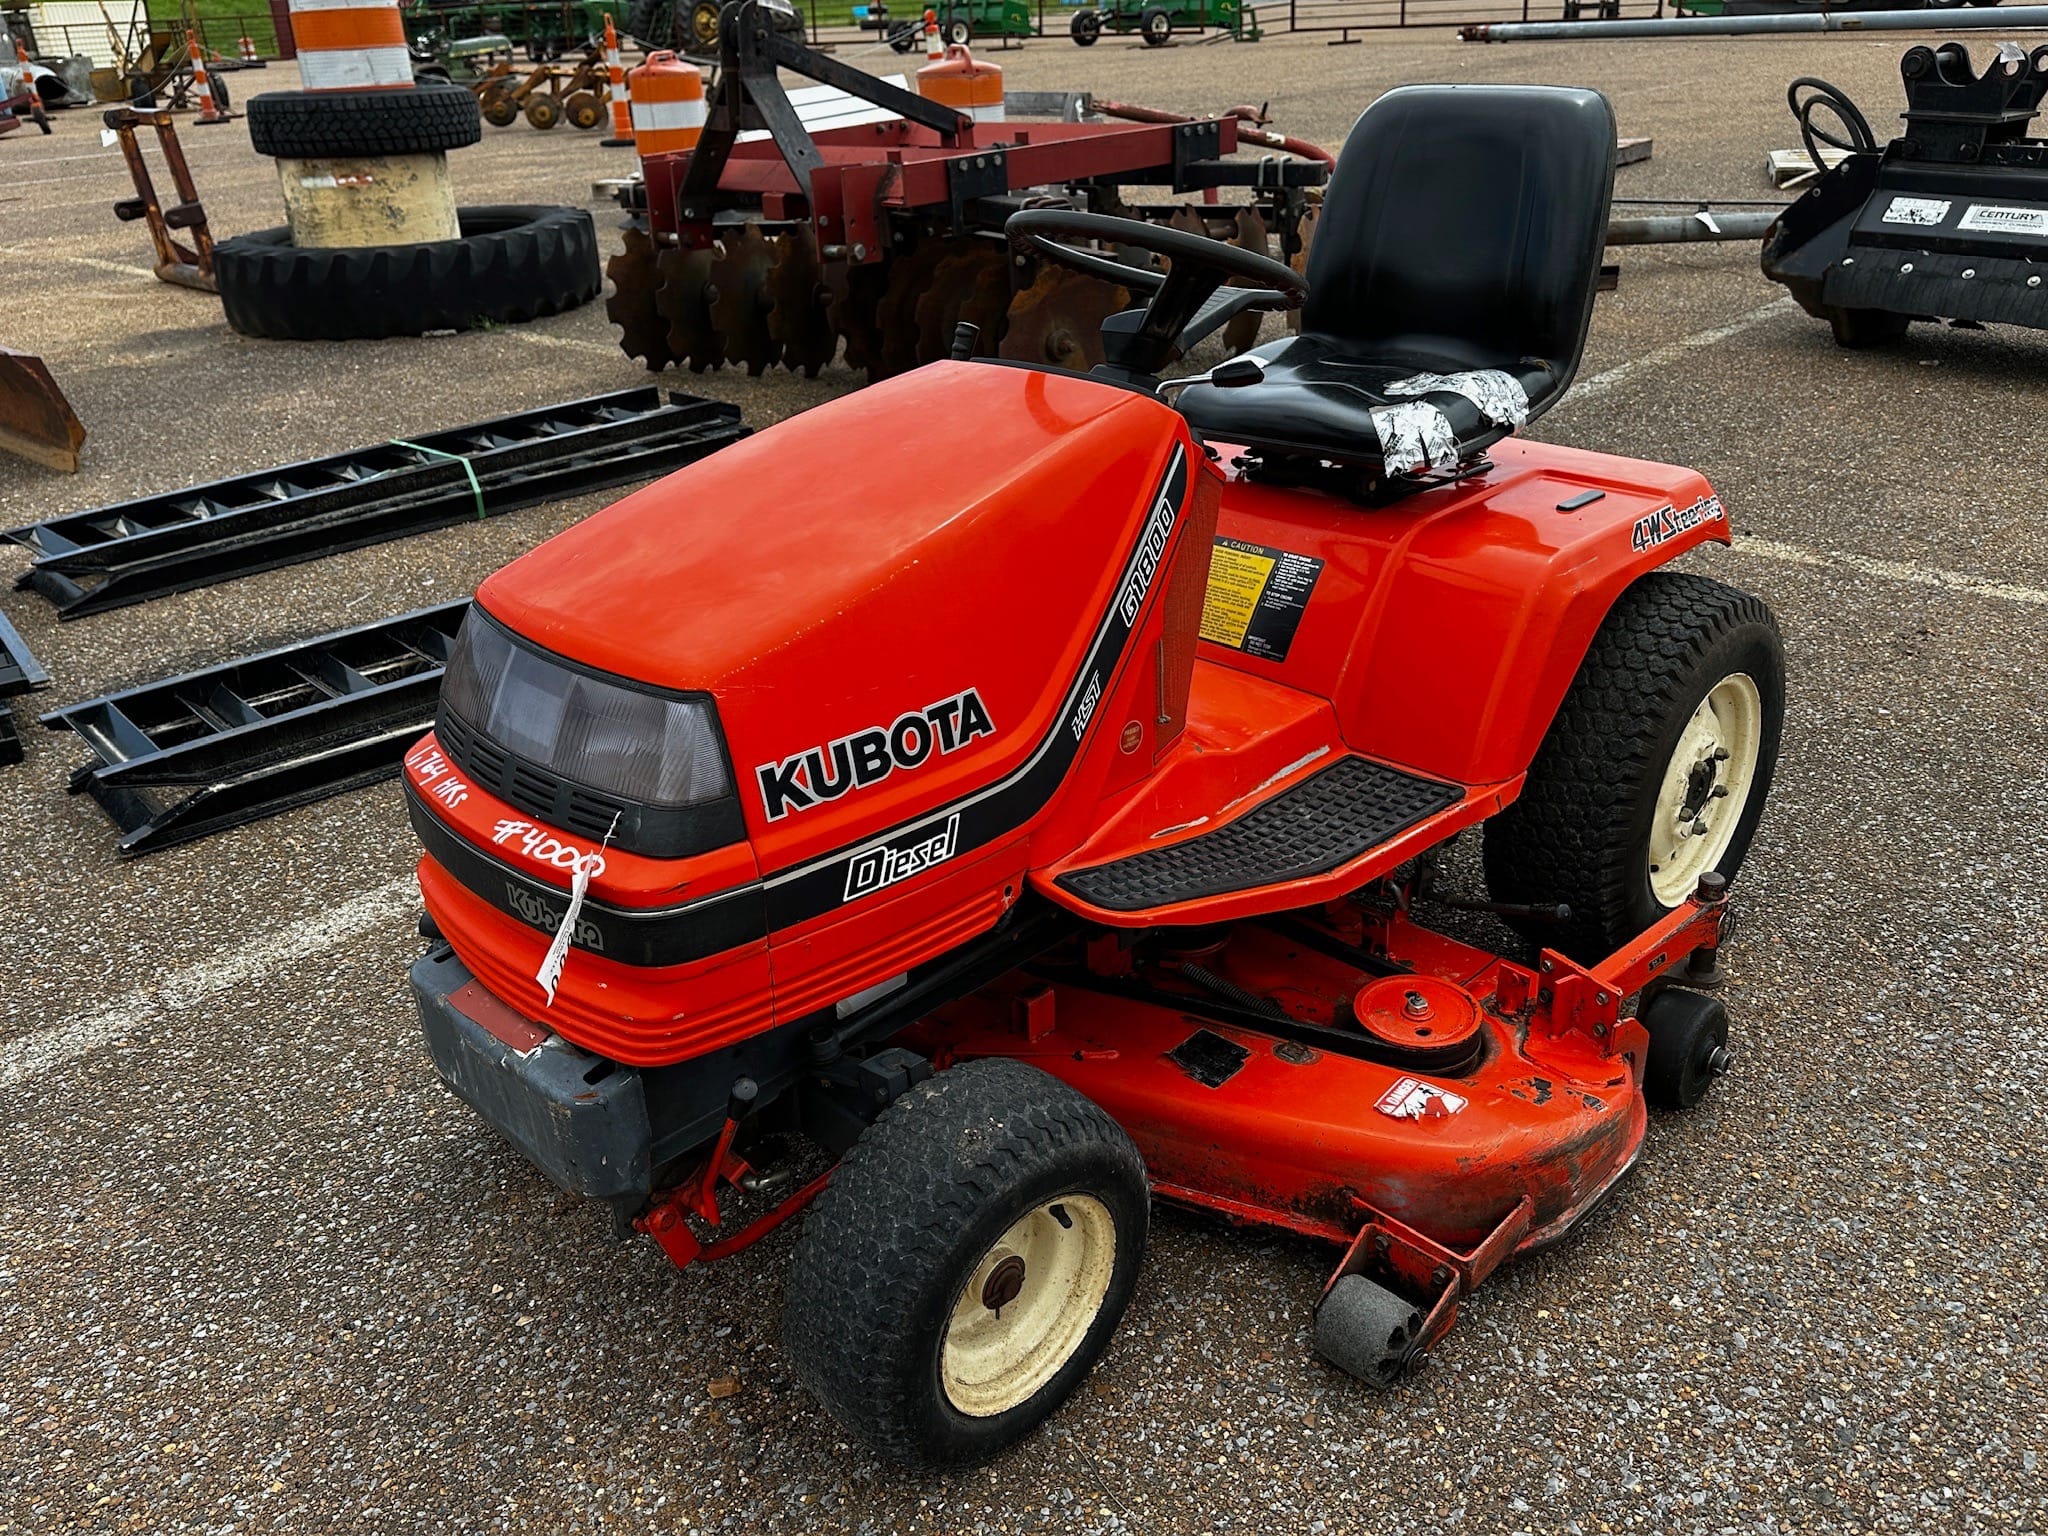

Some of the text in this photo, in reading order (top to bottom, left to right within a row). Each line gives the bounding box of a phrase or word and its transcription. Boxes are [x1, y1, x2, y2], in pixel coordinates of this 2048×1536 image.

[1978, 209, 2040, 221] CENTURY
[1120, 498, 1174, 628] G1800
[1230, 541, 1265, 555] CAUTION
[1071, 669, 1101, 742] HST
[755, 687, 997, 823] KUBOTA
[491, 819, 606, 878] #4000
[843, 813, 961, 903] Diesel
